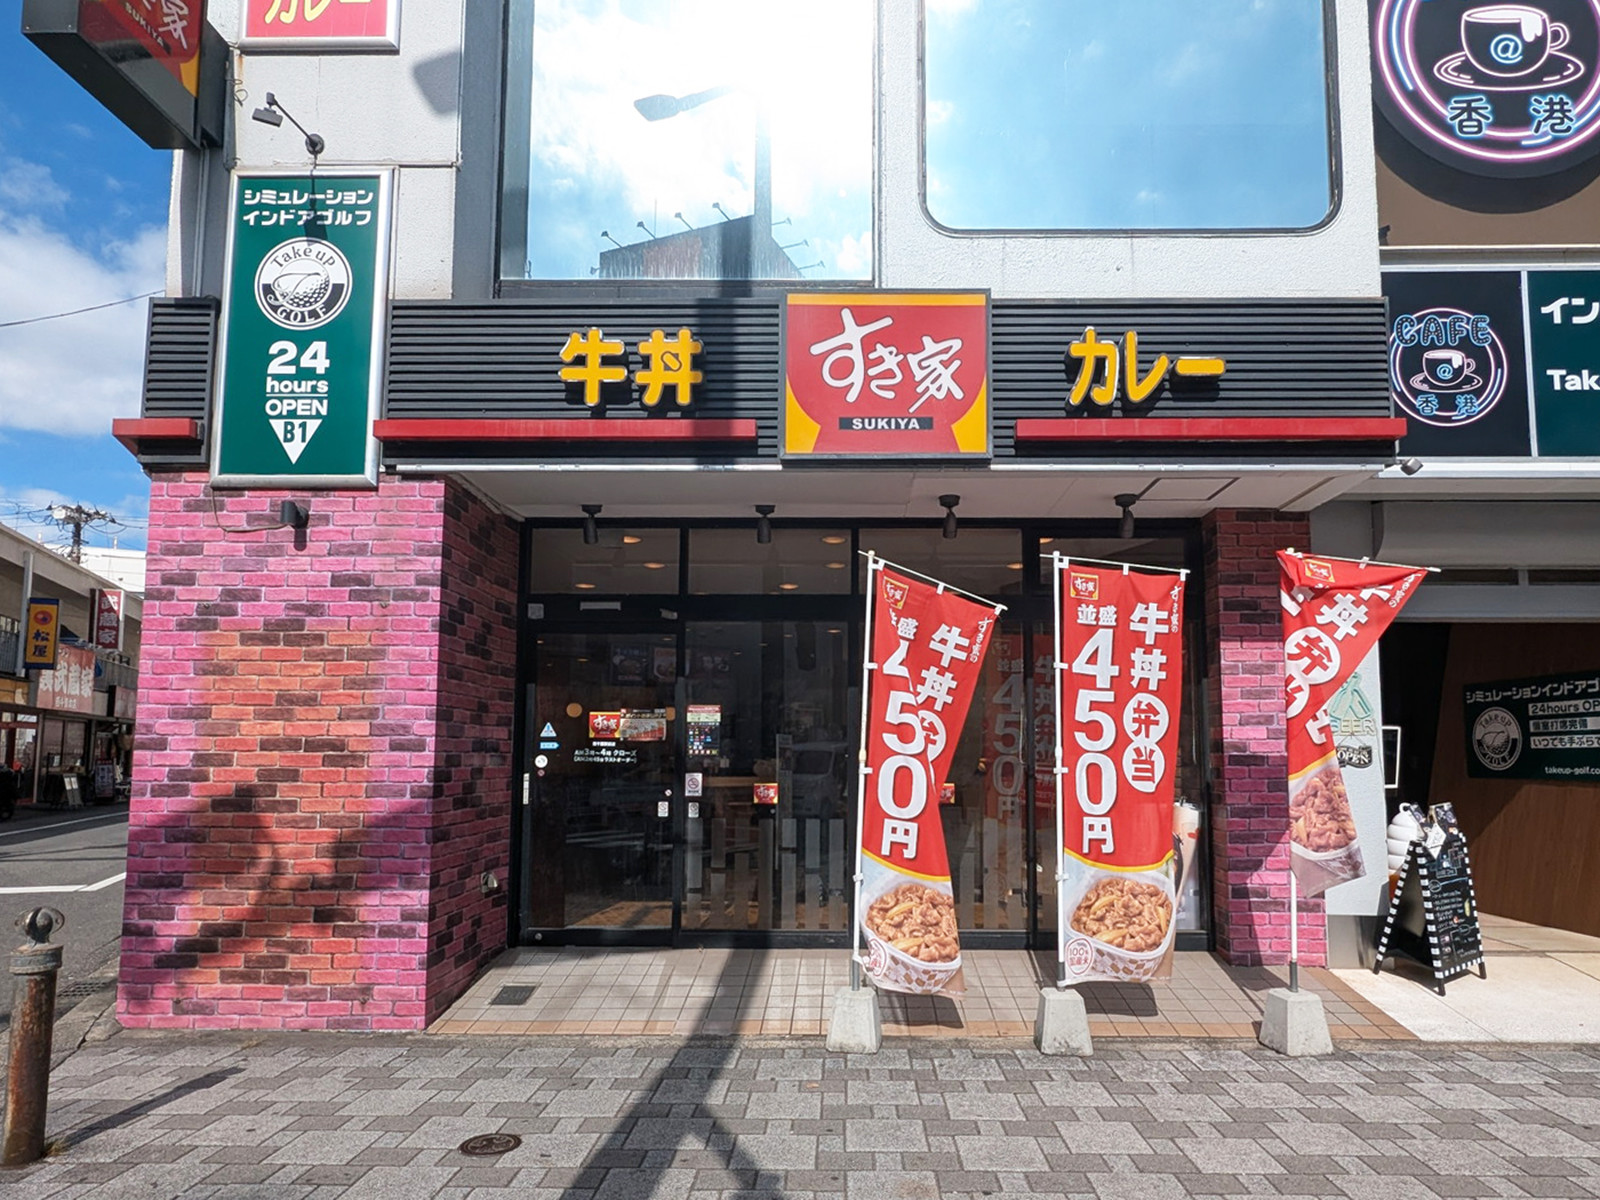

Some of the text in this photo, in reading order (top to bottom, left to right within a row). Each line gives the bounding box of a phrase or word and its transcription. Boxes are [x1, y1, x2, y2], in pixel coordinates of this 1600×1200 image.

[264, 0, 372, 24] カレ
[1447, 95, 1575, 137] 香港
[244, 189, 374, 206] シミュレーション
[243, 209, 372, 226] インドアゴルフ
[270, 245, 336, 269] Take up
[276, 304, 328, 323] GOLF
[1541, 297, 1600, 325] イン
[1394, 314, 1492, 346] CAFE
[266, 340, 330, 374] 24
[558, 326, 703, 406] 牛丼
[809, 307, 965, 414] すき家
[1068, 325, 1226, 405] カレー
[266, 376, 329, 393] hours
[265, 398, 328, 416] OPEN
[283, 420, 308, 444] B1
[852, 417, 920, 429] SUKIYA
[1076, 603, 1117, 626] 並盛
[32, 628, 51, 657] 松屋
[969, 616, 993, 663] すき家の
[1123, 602, 1169, 791] 牛丼弁当
[1465, 677, 1600, 704] シミュレーションインドアゴ
[1531, 702, 1580, 714] 24hours
[1072, 628, 1119, 854] 450円
